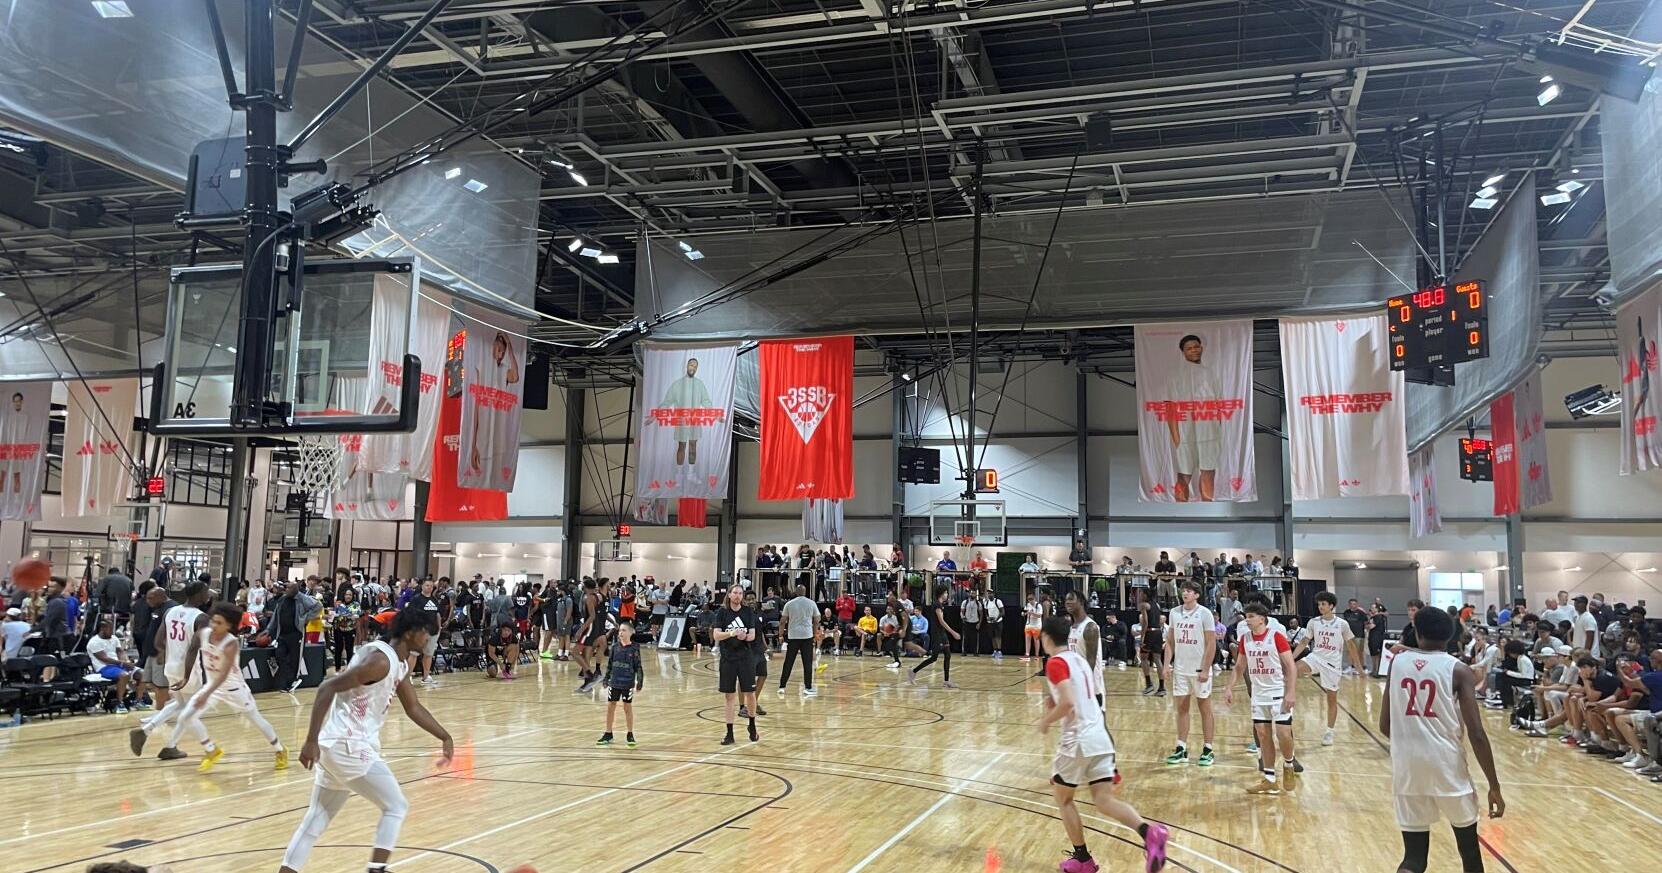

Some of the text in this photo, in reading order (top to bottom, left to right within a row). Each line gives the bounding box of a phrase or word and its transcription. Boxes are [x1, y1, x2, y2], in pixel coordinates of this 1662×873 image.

[1456, 283, 1478, 293] Guests
[1470, 292, 1480, 308] 0
[1401, 306, 1410, 322] 0
[1425, 315, 1442, 326] period
[1451, 310, 1456, 321] 1
[1425, 327, 1444, 337] player
[1470, 331, 1478, 345] 0
[1396, 345, 1404, 357] 0
[469, 384, 518, 404] REMEMBER
[788, 386, 827, 409] 3SSB
[1301, 391, 1393, 406] REMEMBER
[1145, 398, 1244, 411] REMEMBER
[1310, 402, 1384, 415] THE WHY
[651, 408, 724, 418] REMEMBER
[1155, 410, 1234, 422] THE WHY
[656, 417, 717, 427] THE WHY
[985, 471, 996, 488] 0
[620, 525, 630, 535] 30
[170, 620, 186, 641] 33
[1255, 657, 1264, 668] 15
[1400, 677, 1438, 718] 22
